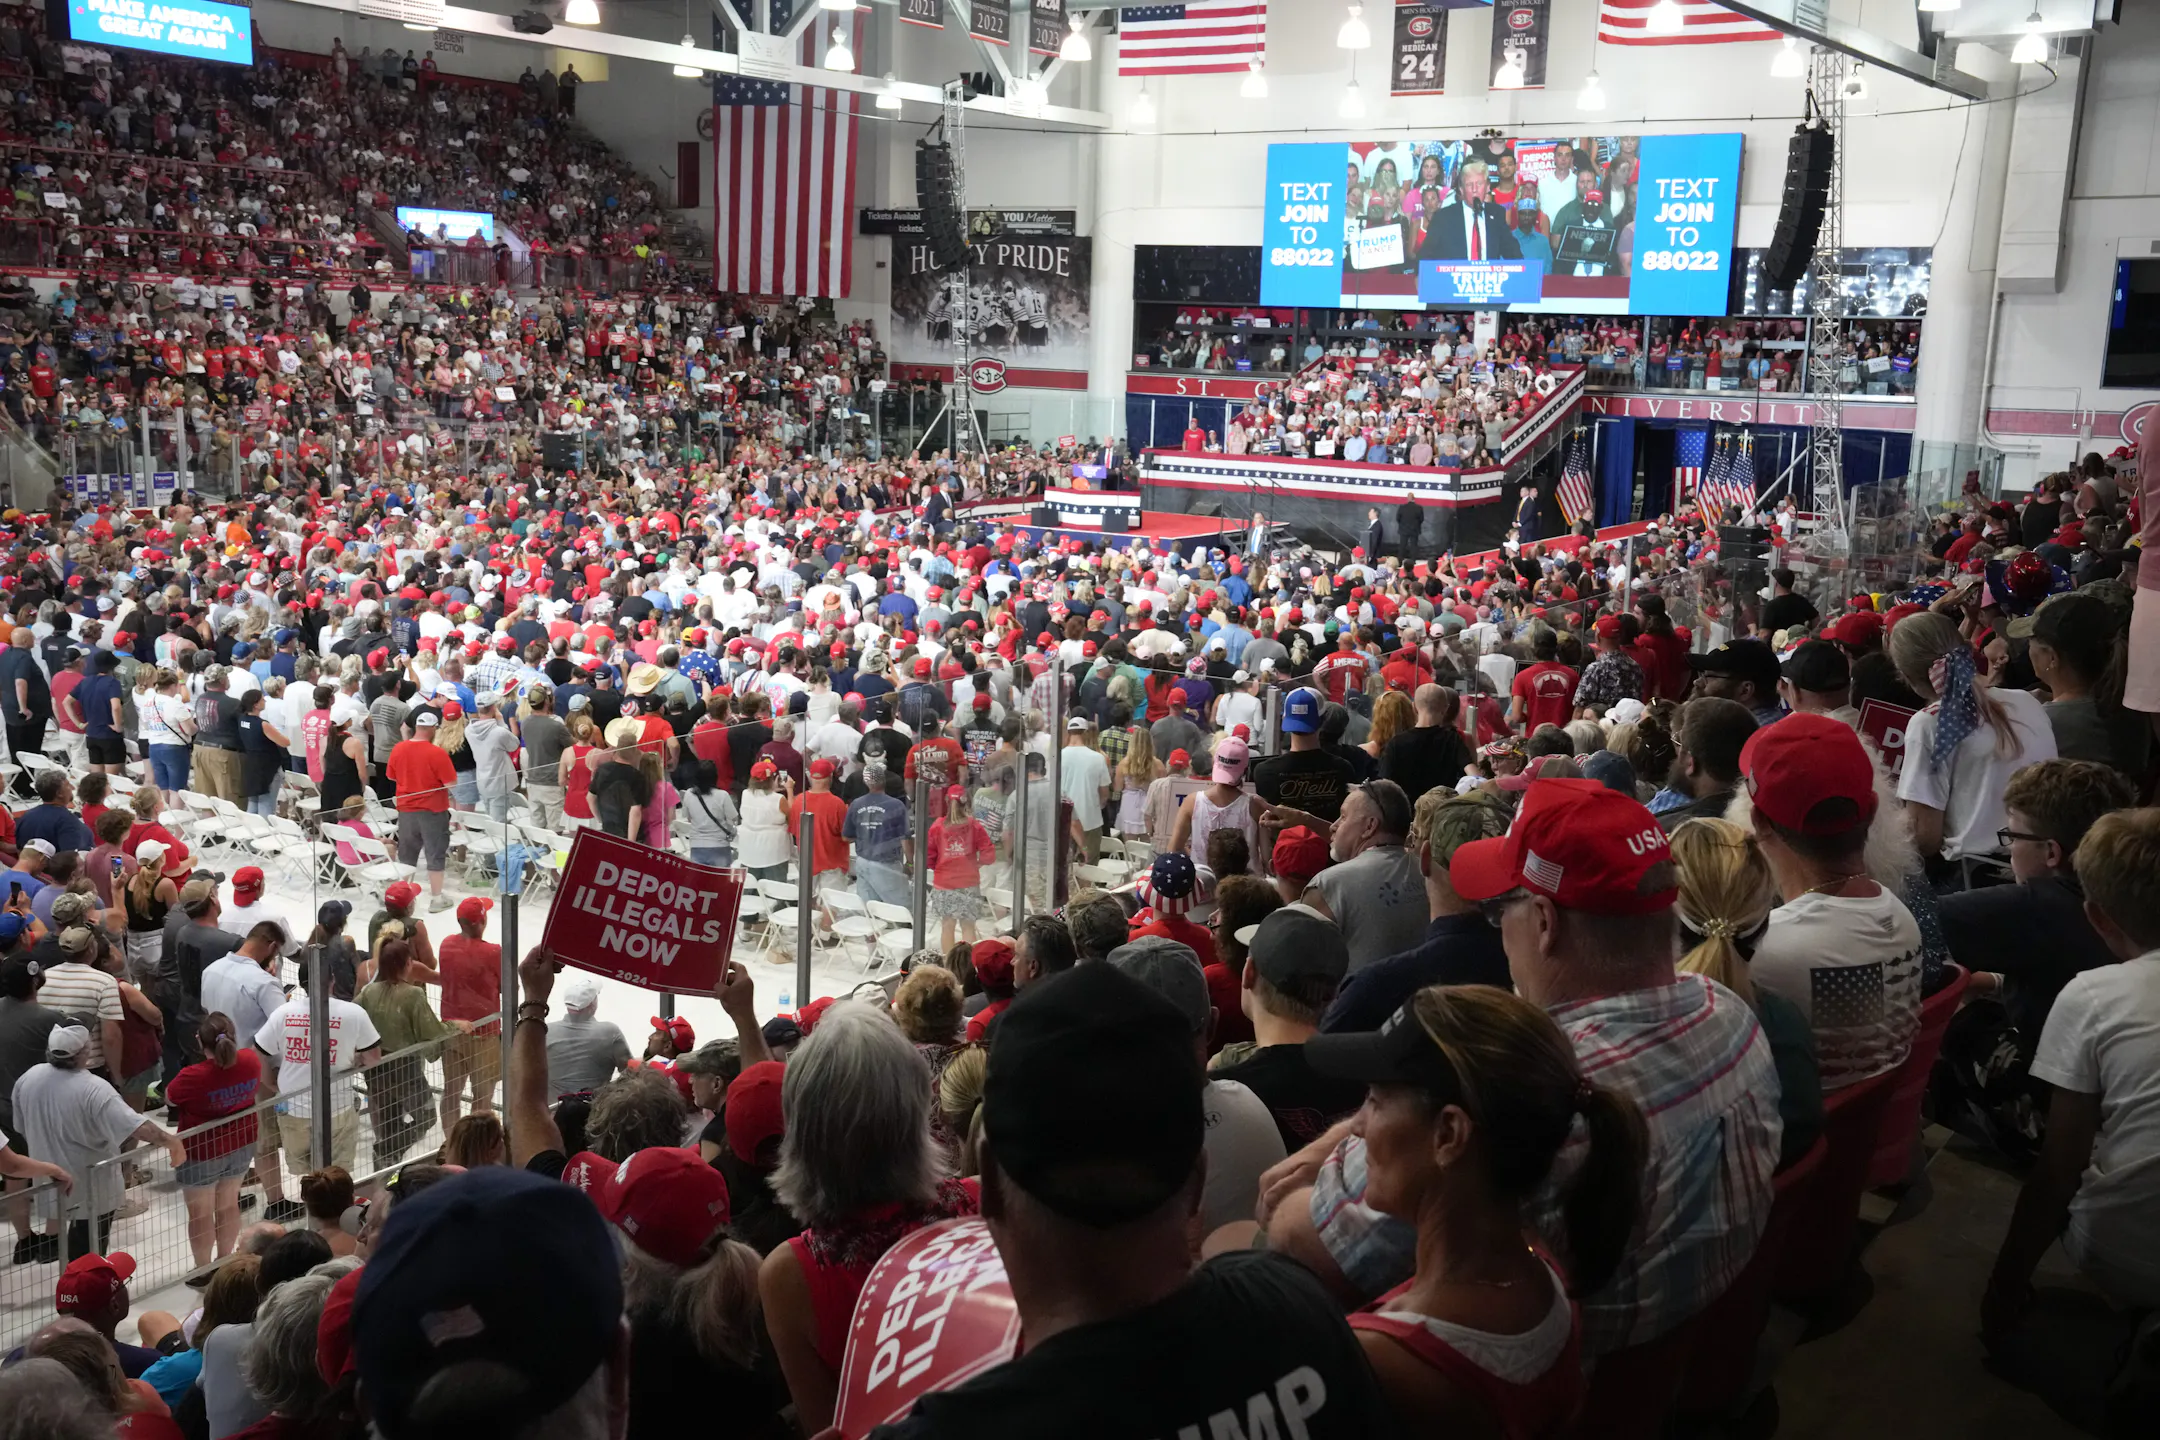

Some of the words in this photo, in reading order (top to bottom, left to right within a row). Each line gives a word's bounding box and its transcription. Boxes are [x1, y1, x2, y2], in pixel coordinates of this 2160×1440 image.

[88, 0, 146, 19] MAKE
[149, 5, 235, 34] AMERICA
[907, 0, 936, 17] 2021
[98, 15, 165, 41] GREAT
[168, 25, 227, 50] AGAIN
[977, 12, 1003, 34] 2022
[433, 31, 464, 44] STUDENT
[1036, 27, 1060, 47] 2023
[1503, 37, 1537, 46] CULLEN
[434, 41, 464, 54] SECTION
[1402, 43, 1438, 52] HEDICAN
[1400, 54, 1436, 80] 24
[1520, 161, 1557, 170] ILLEGAL
[1522, 152, 1555, 161] DEPOR
[1280, 183, 1332, 201] TEXT
[1655, 178, 1719, 198] TEXT
[867, 211, 892, 221] Tickets
[893, 212, 921, 221] Availabl
[1002, 212, 1024, 222] YOU
[1025, 212, 1056, 223] Matter
[1279, 204, 1329, 223] JOIN
[1653, 202, 1714, 223] JOIN
[1289, 226, 1317, 245] TO
[1356, 234, 1397, 248] TRUMP
[1570, 230, 1608, 242] NEVER
[1665, 226, 1699, 247] TO
[997, 243, 1070, 277] PRIDE
[1270, 248, 1334, 267] 88022
[1642, 250, 1719, 271] 88022
[1451, 272, 1509, 285] TRUMP
[1456, 283, 1502, 294] VANCE
[1176, 378, 1225, 397] ST.
[1333, 657, 1364, 668] AMERICA
[1217, 755, 1242, 766] TRUMP
[1279, 778, 1339, 799] O'Neill
[1626, 826, 1668, 856] USA
[593, 860, 719, 915] DEPORT
[571, 885, 722, 944] ILLEGALS
[598, 924, 681, 967] NOW
[615, 969, 648, 986] 2024
[207, 1078, 258, 1101] TRUMP
[60, 1293, 79, 1304] USA
[866, 1220, 992, 1395] DEPOR
